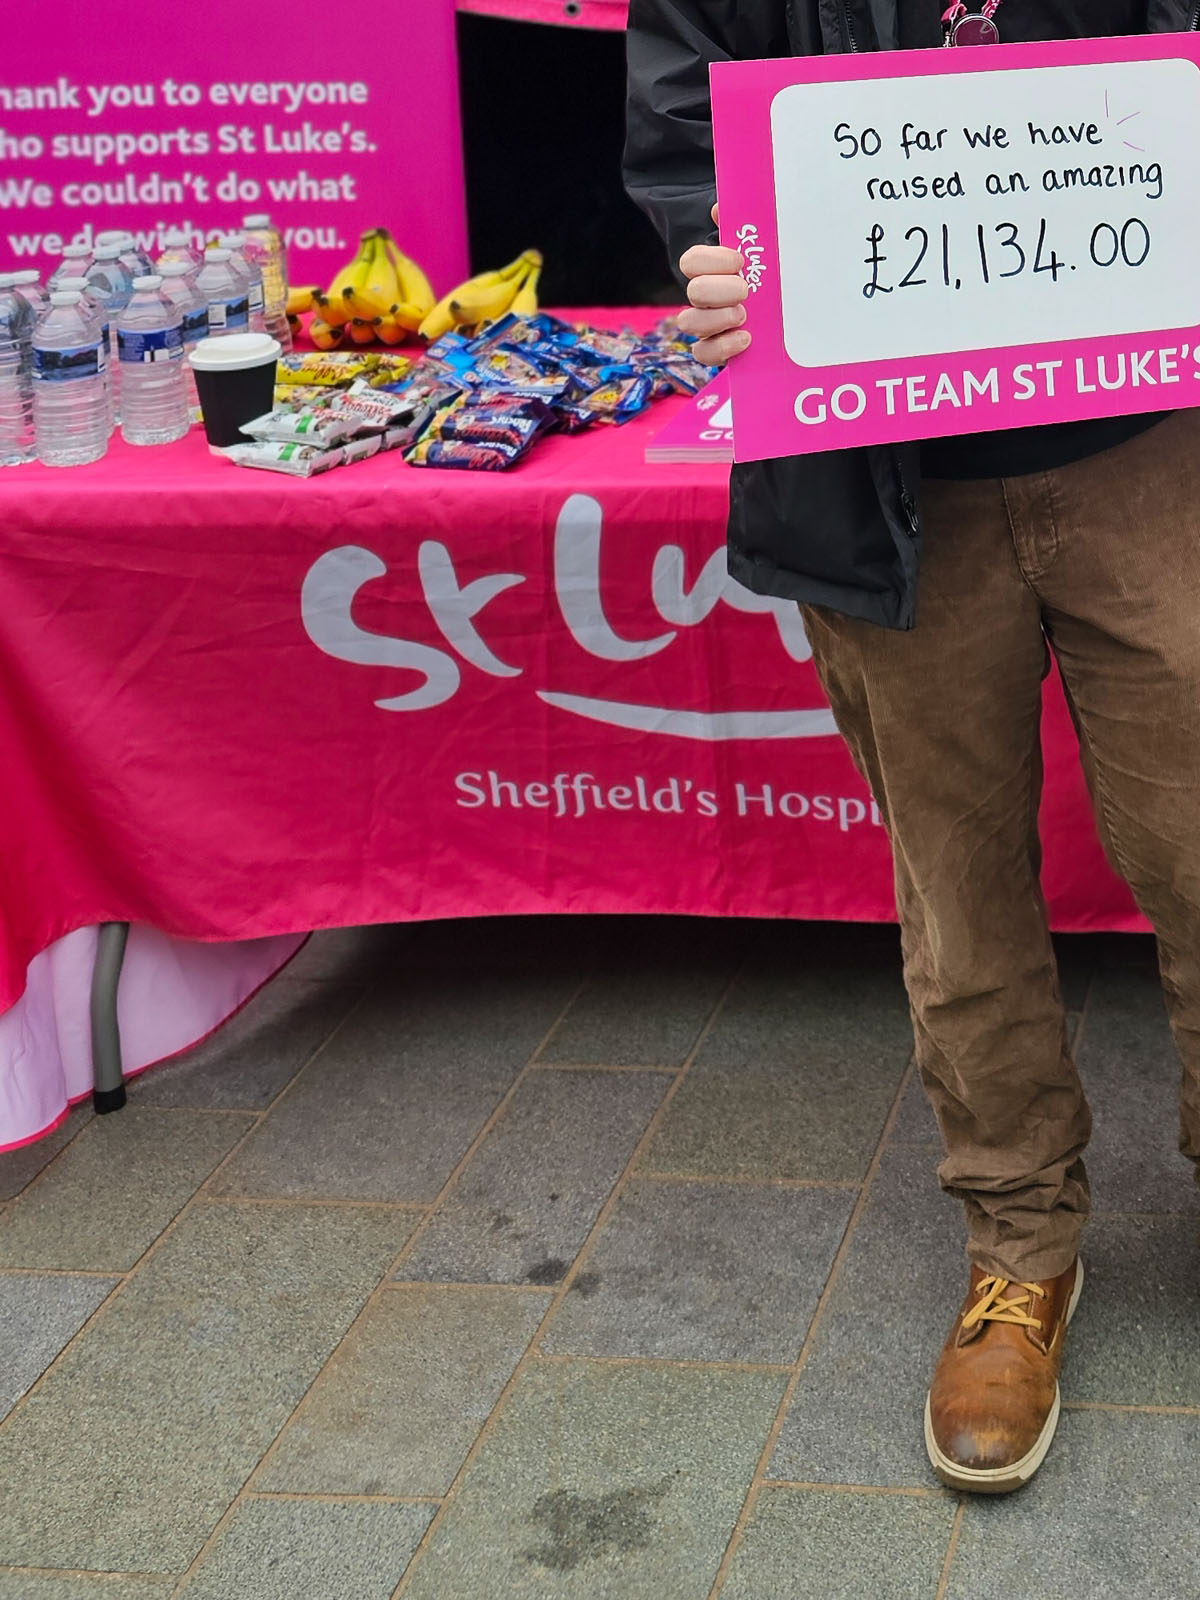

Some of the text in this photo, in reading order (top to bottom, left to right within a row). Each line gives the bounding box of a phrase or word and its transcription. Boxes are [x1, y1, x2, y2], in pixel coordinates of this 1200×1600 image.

[86, 85, 154, 116] you
[162, 78, 201, 106] to
[209, 81, 369, 113] everyone
[0, 121, 376, 165] ho supports St Luke's.
[834, 123, 881, 159] So
[900, 123, 948, 159] far
[1028, 121, 1103, 146] have
[0, 170, 357, 208] We couldn't do what
[867, 164, 1164, 200] raised an amazing
[8, 231, 63, 256] we
[863, 217, 1151, 298] £21,134.00
[794, 384, 866, 426] GO
[876, 368, 1000, 415] TEAM
[1013, 360, 1064, 401] ST
[454, 770, 884, 832] Sheffield's Hospi
